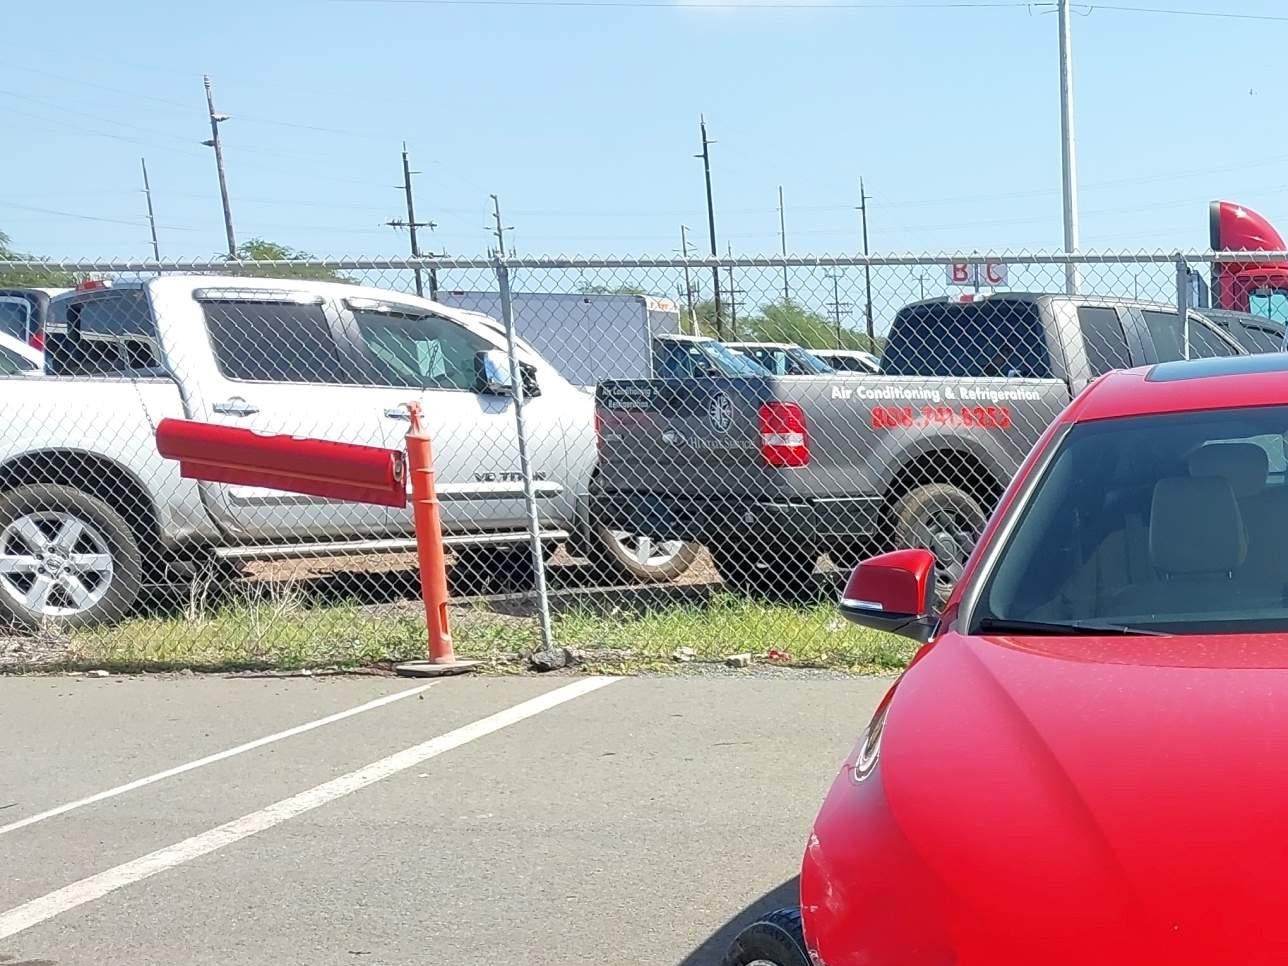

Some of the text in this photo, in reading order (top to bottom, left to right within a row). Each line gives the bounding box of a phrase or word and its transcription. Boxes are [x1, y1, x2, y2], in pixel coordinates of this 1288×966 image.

[953, 262, 968, 281] B
[987, 262, 1001, 282] C
[831, 386, 1040, 403] Air Conditioning & Refrigeration
